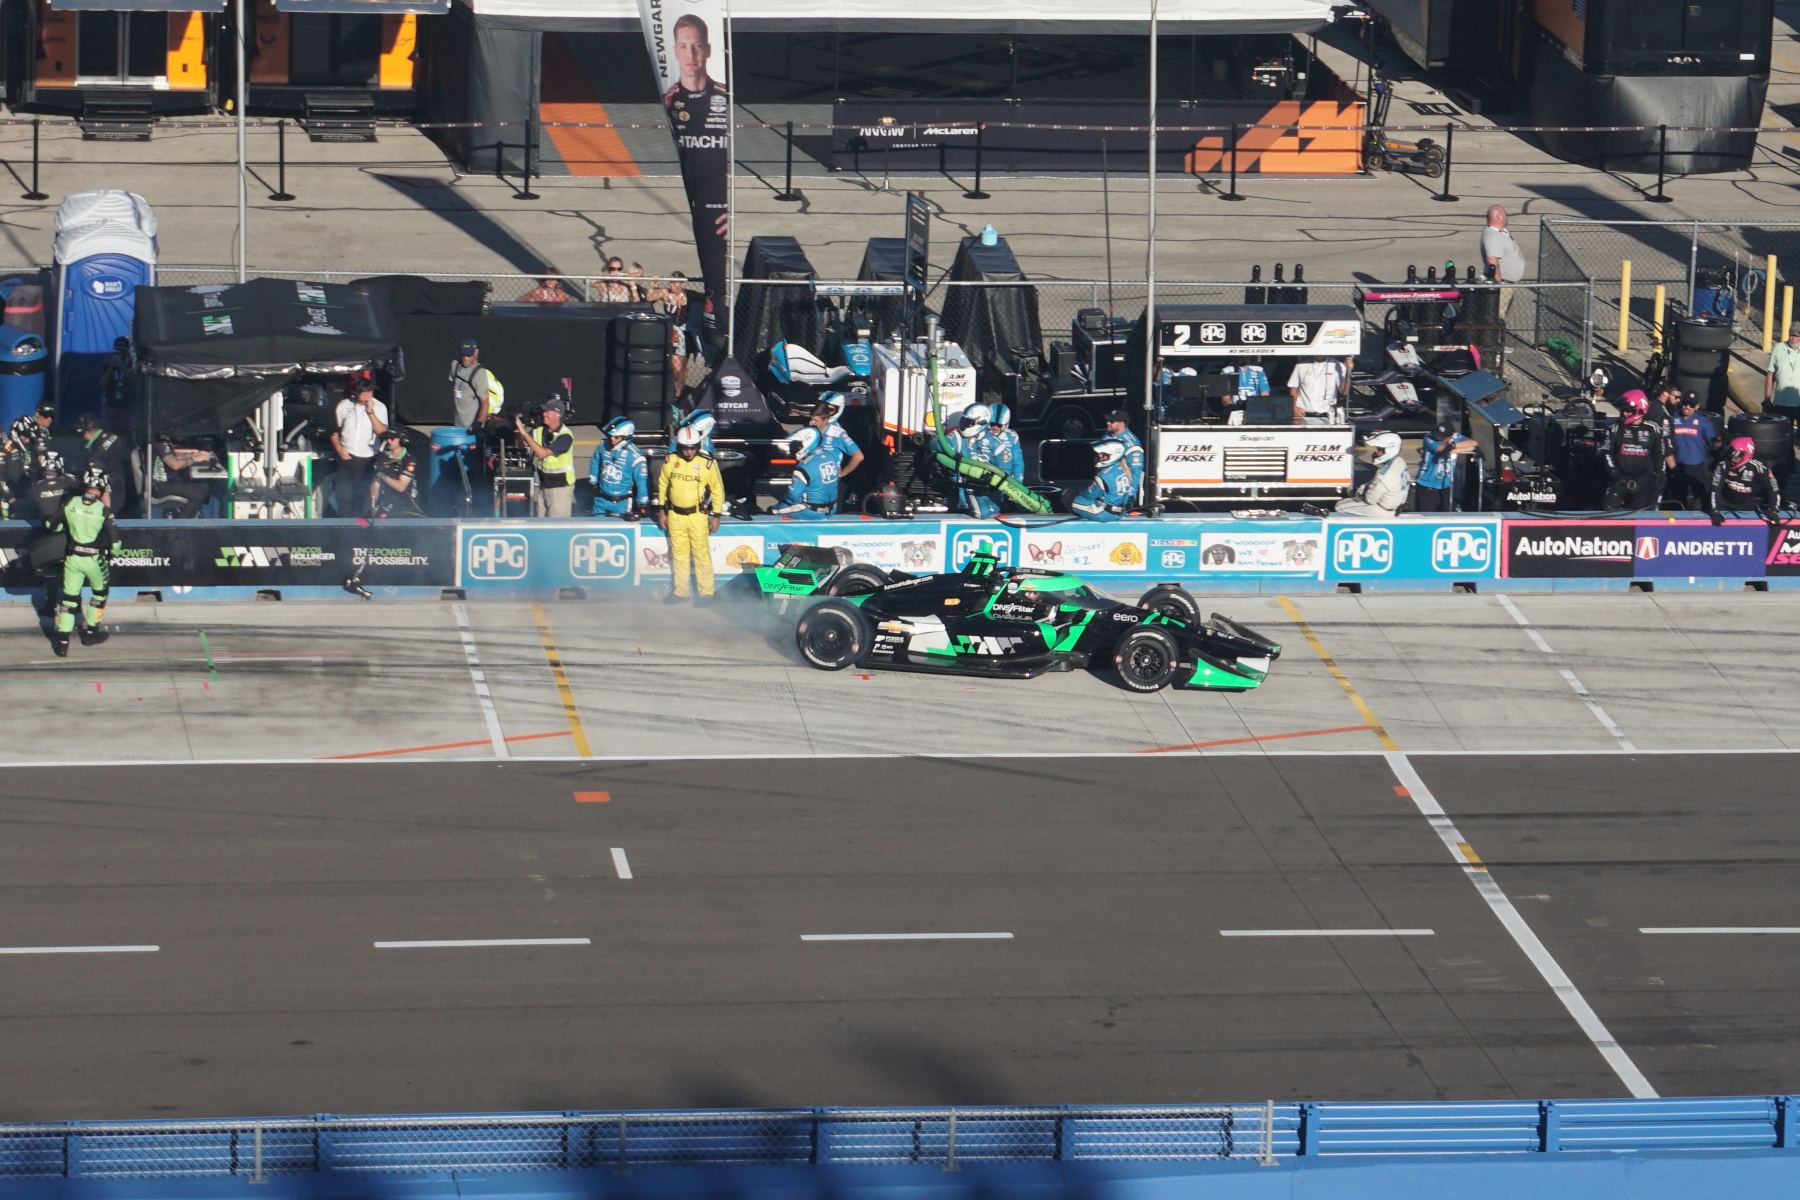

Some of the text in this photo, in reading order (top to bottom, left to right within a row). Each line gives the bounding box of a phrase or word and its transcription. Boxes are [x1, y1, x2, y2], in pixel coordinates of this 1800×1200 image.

[923, 127, 979, 135] McLaren
[1174, 324, 1306, 352] 2 PPG PPG PPG
[1176, 444, 1213, 452] TEAM
[1304, 444, 1341, 452] TEAM
[1165, 454, 1217, 462] PENSKE
[1294, 454, 1345, 462] PENSKE
[670, 472, 702, 482] OFFICIAL
[1337, 533, 1389, 568] PPG
[1436, 532, 1487, 567] PPG
[1515, 536, 1633, 556] AutoNation
[1664, 541, 1753, 556] ANDRETTI
[290, 553, 336, 561] HOLLINGER
[374, 548, 412, 557] POWER
[472, 539, 524, 575] PPG
[574, 538, 625, 574] PPG
[369, 557, 429, 566] POSSIBILITY.
[970, 557, 995, 577] 77
[992, 602, 1035, 614] DNSFilter
[1113, 612, 1139, 623] eero
